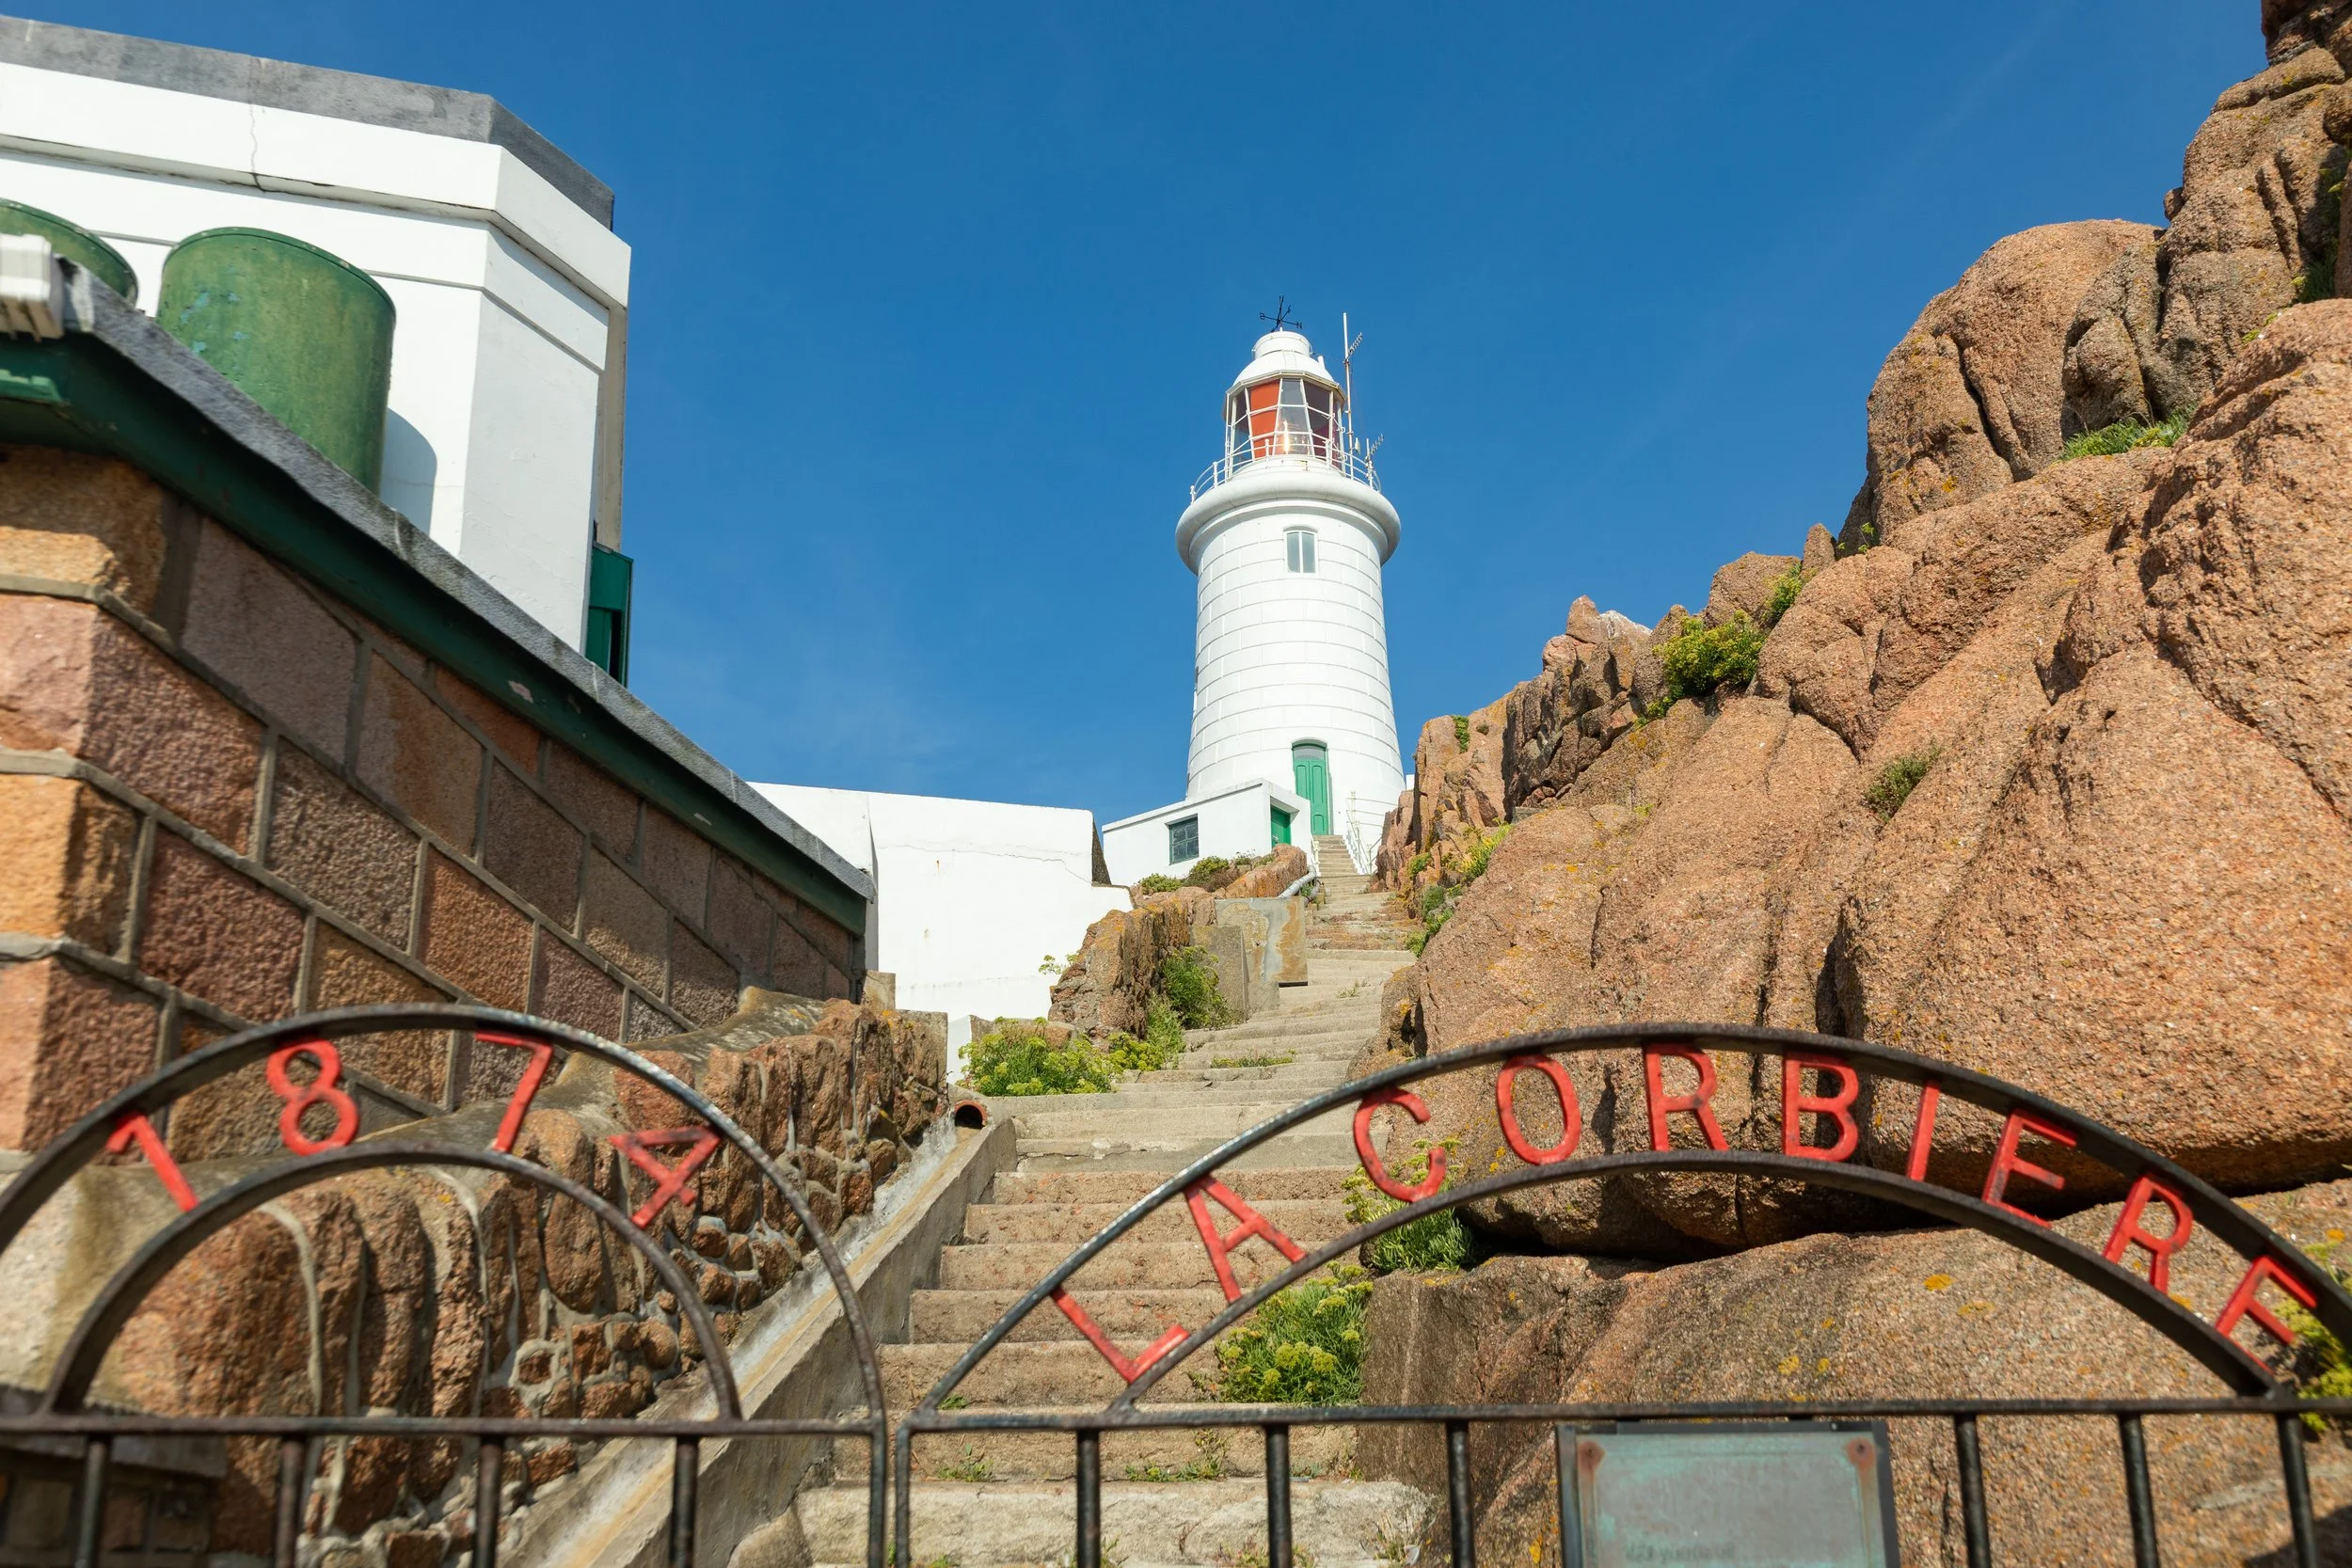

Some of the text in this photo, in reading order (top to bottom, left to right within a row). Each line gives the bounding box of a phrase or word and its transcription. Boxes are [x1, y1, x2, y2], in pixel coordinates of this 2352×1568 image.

[105, 1031, 722, 1229] 1874
[1051, 1042, 2318, 1384] LA CORBIERE
